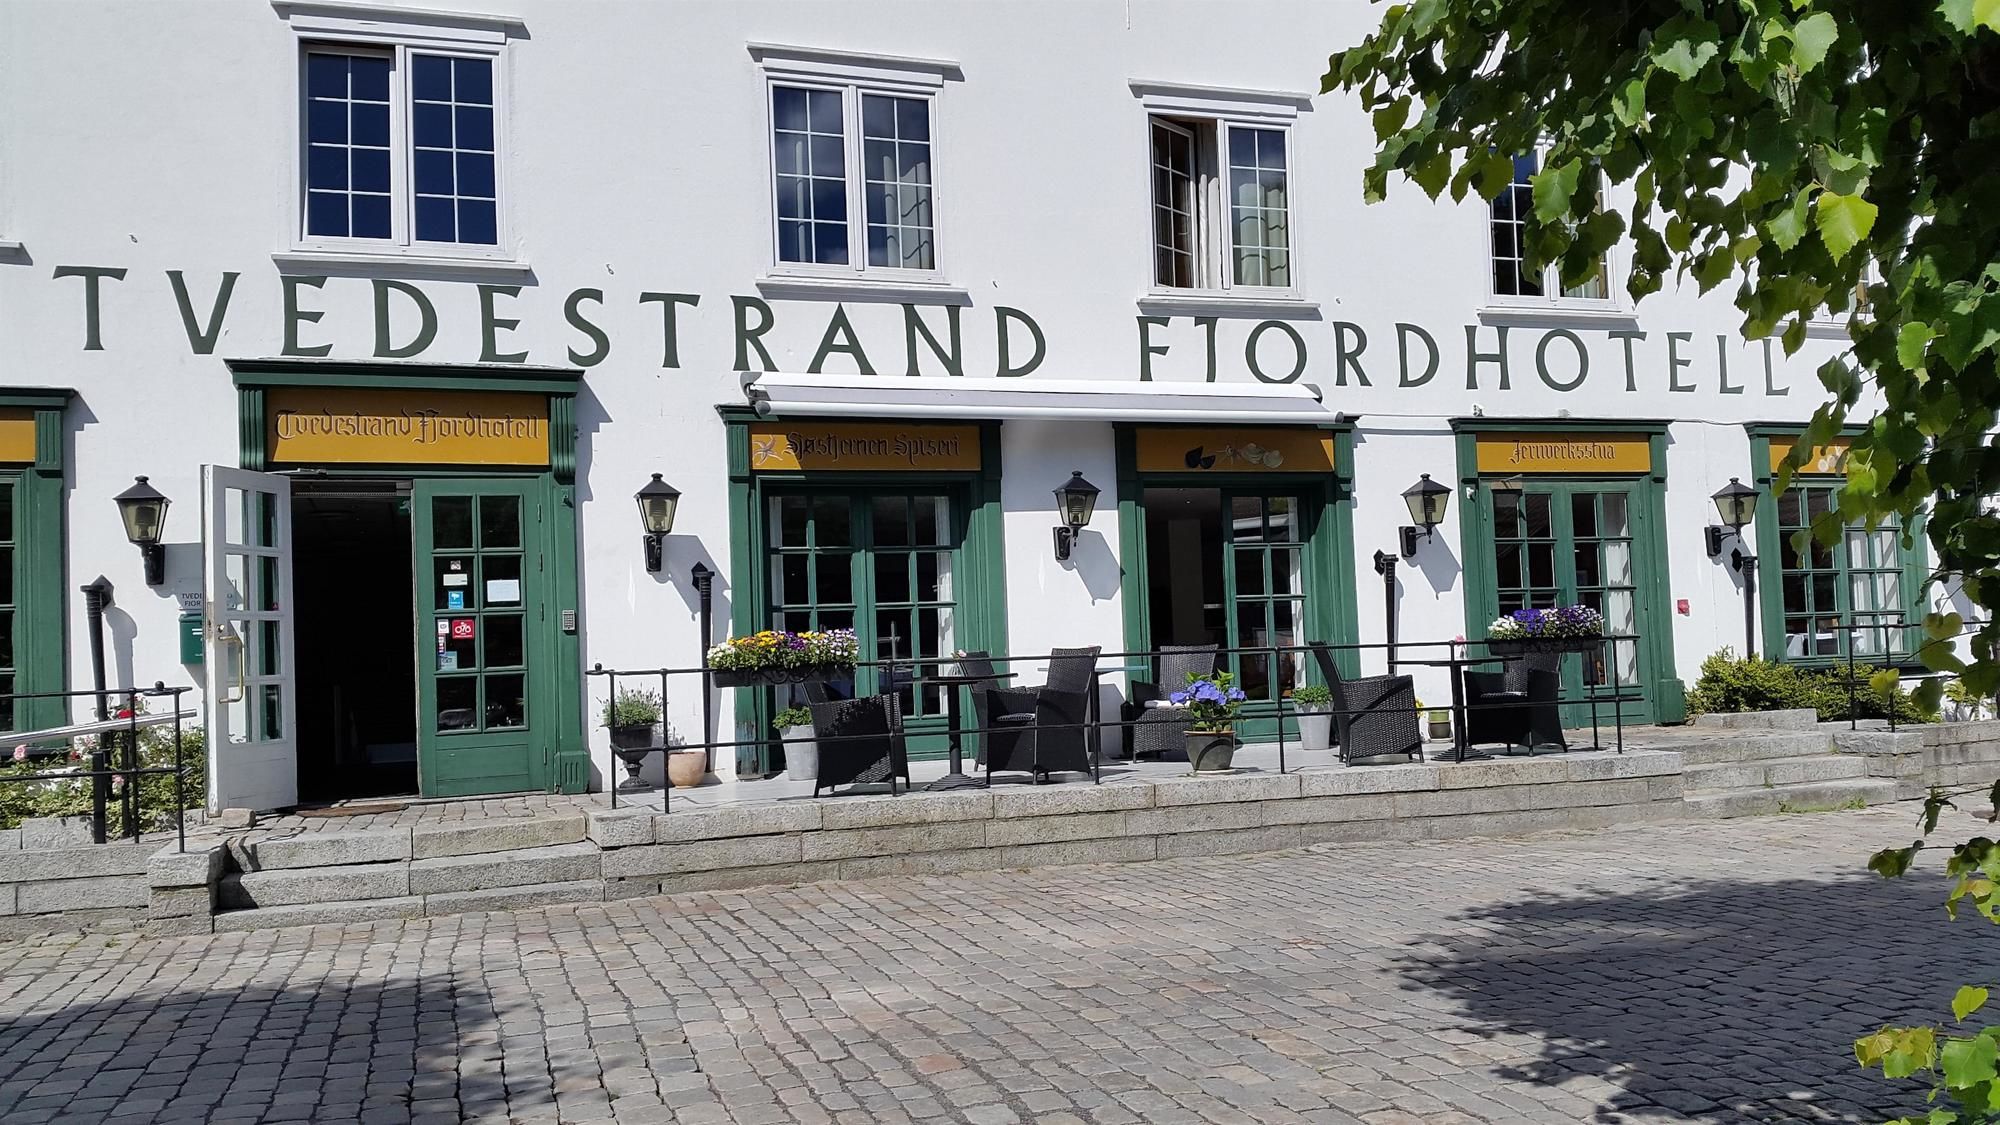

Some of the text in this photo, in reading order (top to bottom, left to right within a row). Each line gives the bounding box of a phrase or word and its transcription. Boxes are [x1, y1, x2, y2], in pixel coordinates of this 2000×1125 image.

[53, 265, 1790, 396] TVEDESTRAND FJORDHOTELL
[274, 408, 411, 440] Tvedestrand
[893, 432, 960, 465] Spiseri
